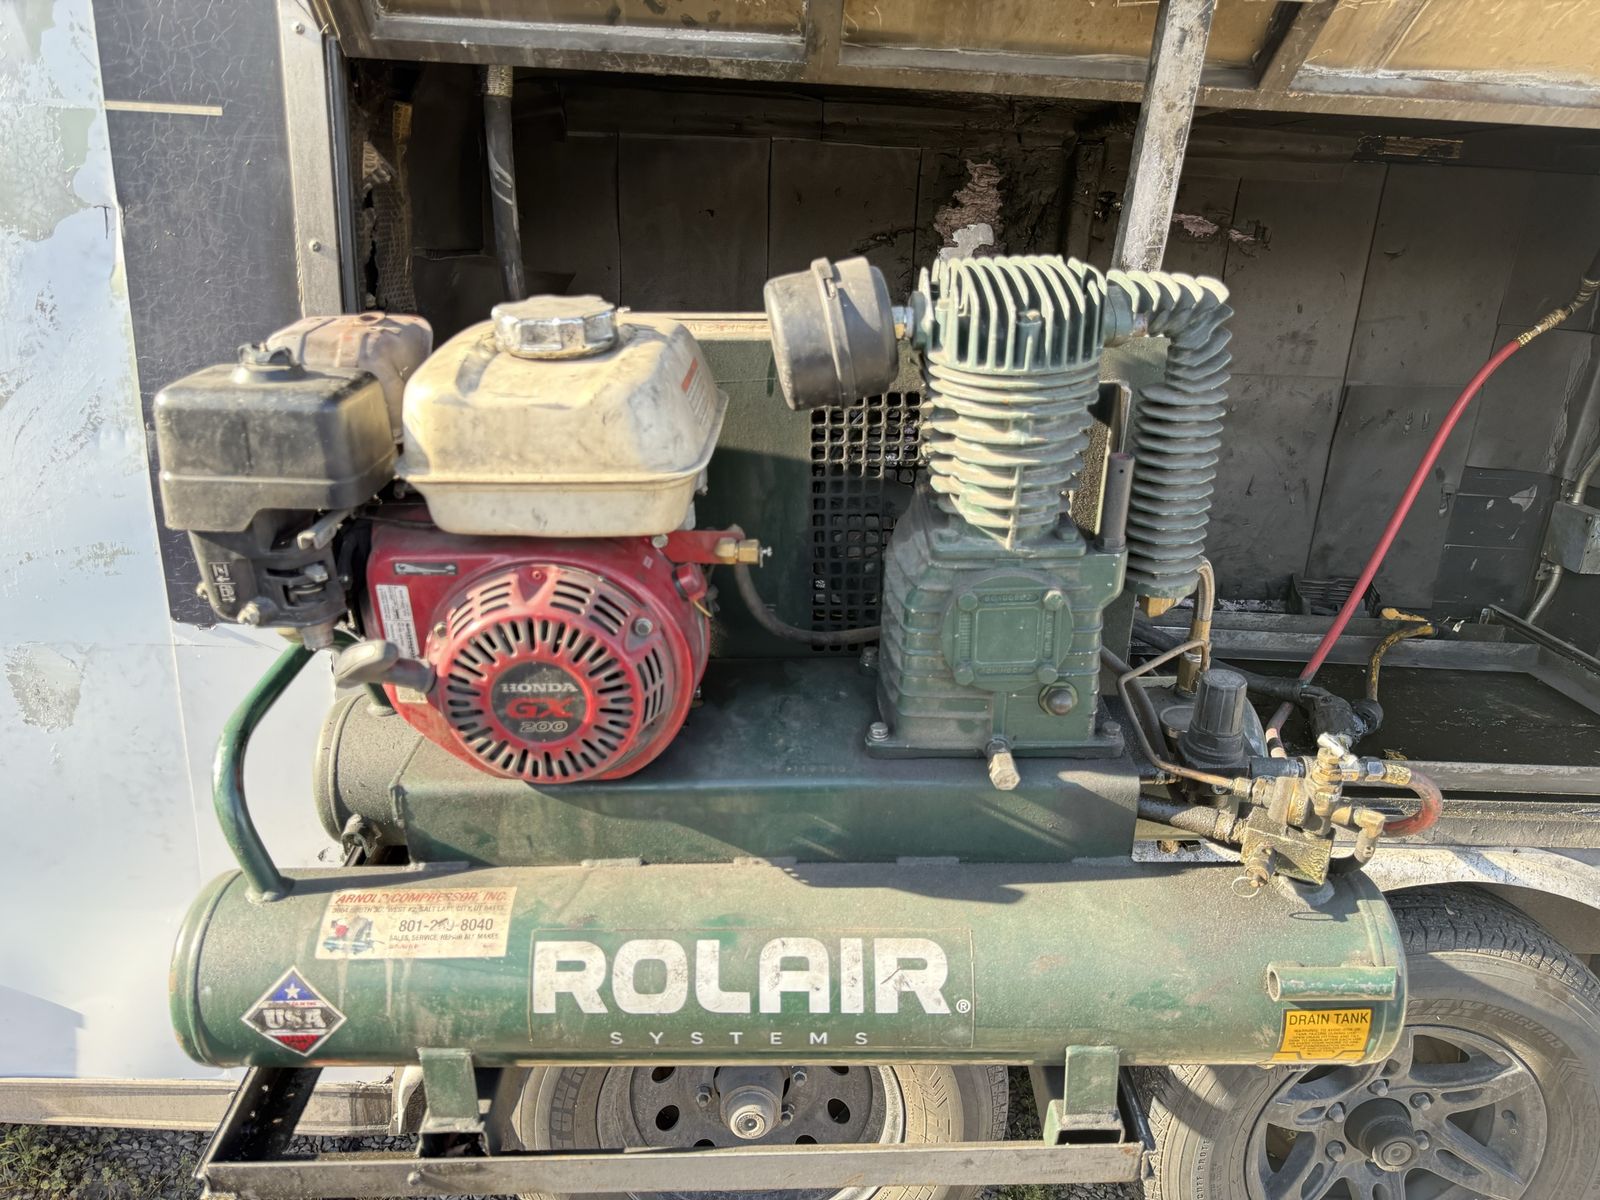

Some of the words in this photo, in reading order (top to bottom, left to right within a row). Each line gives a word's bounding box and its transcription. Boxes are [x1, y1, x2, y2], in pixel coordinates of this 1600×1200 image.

[500, 683, 578, 693] HONDA
[505, 696, 575, 719] GX
[519, 720, 569, 733] 200
[398, 918, 494, 932] 801-20-8040
[262, 1008, 327, 1029] USA
[1289, 1014, 1330, 1026] DRAIN
[1334, 1012, 1369, 1024] TANK
[610, 1031, 869, 1046] SYSTEMS
